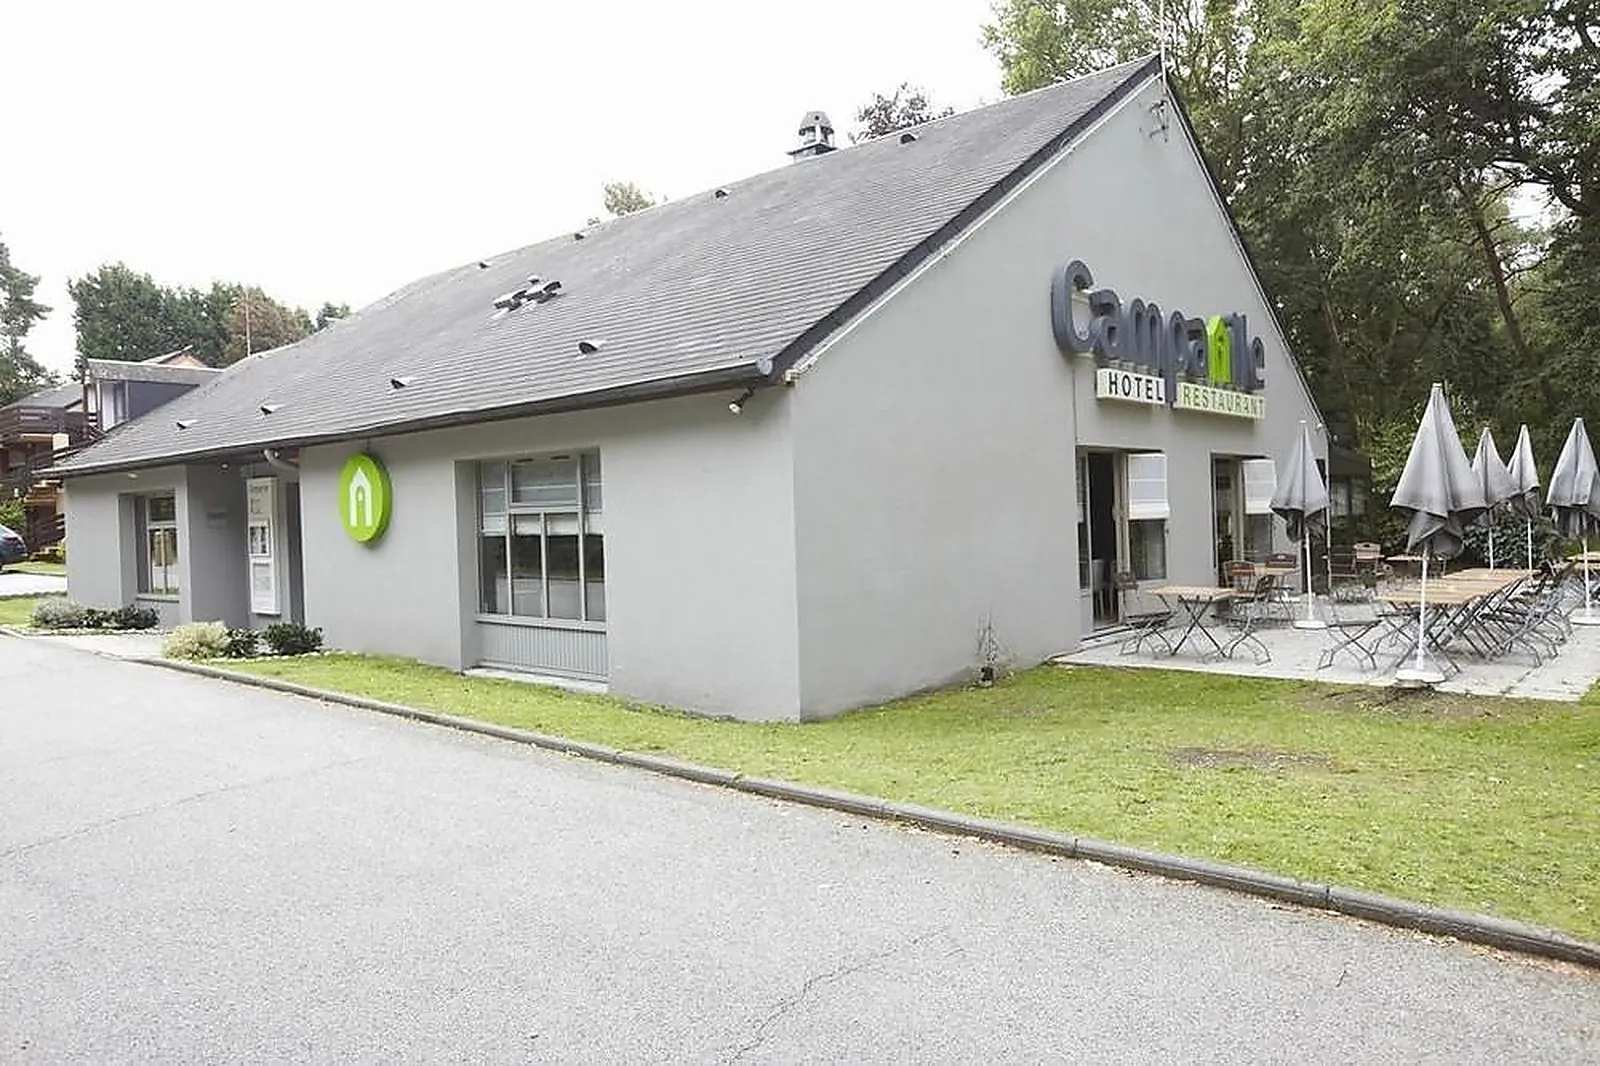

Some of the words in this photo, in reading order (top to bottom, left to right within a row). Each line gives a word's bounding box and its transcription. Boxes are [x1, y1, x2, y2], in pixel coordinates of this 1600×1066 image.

[1051, 259, 1265, 402] Campanile
[1108, 371, 1164, 402] HOTEL
[1183, 385, 1265, 416] RESTAURANT
